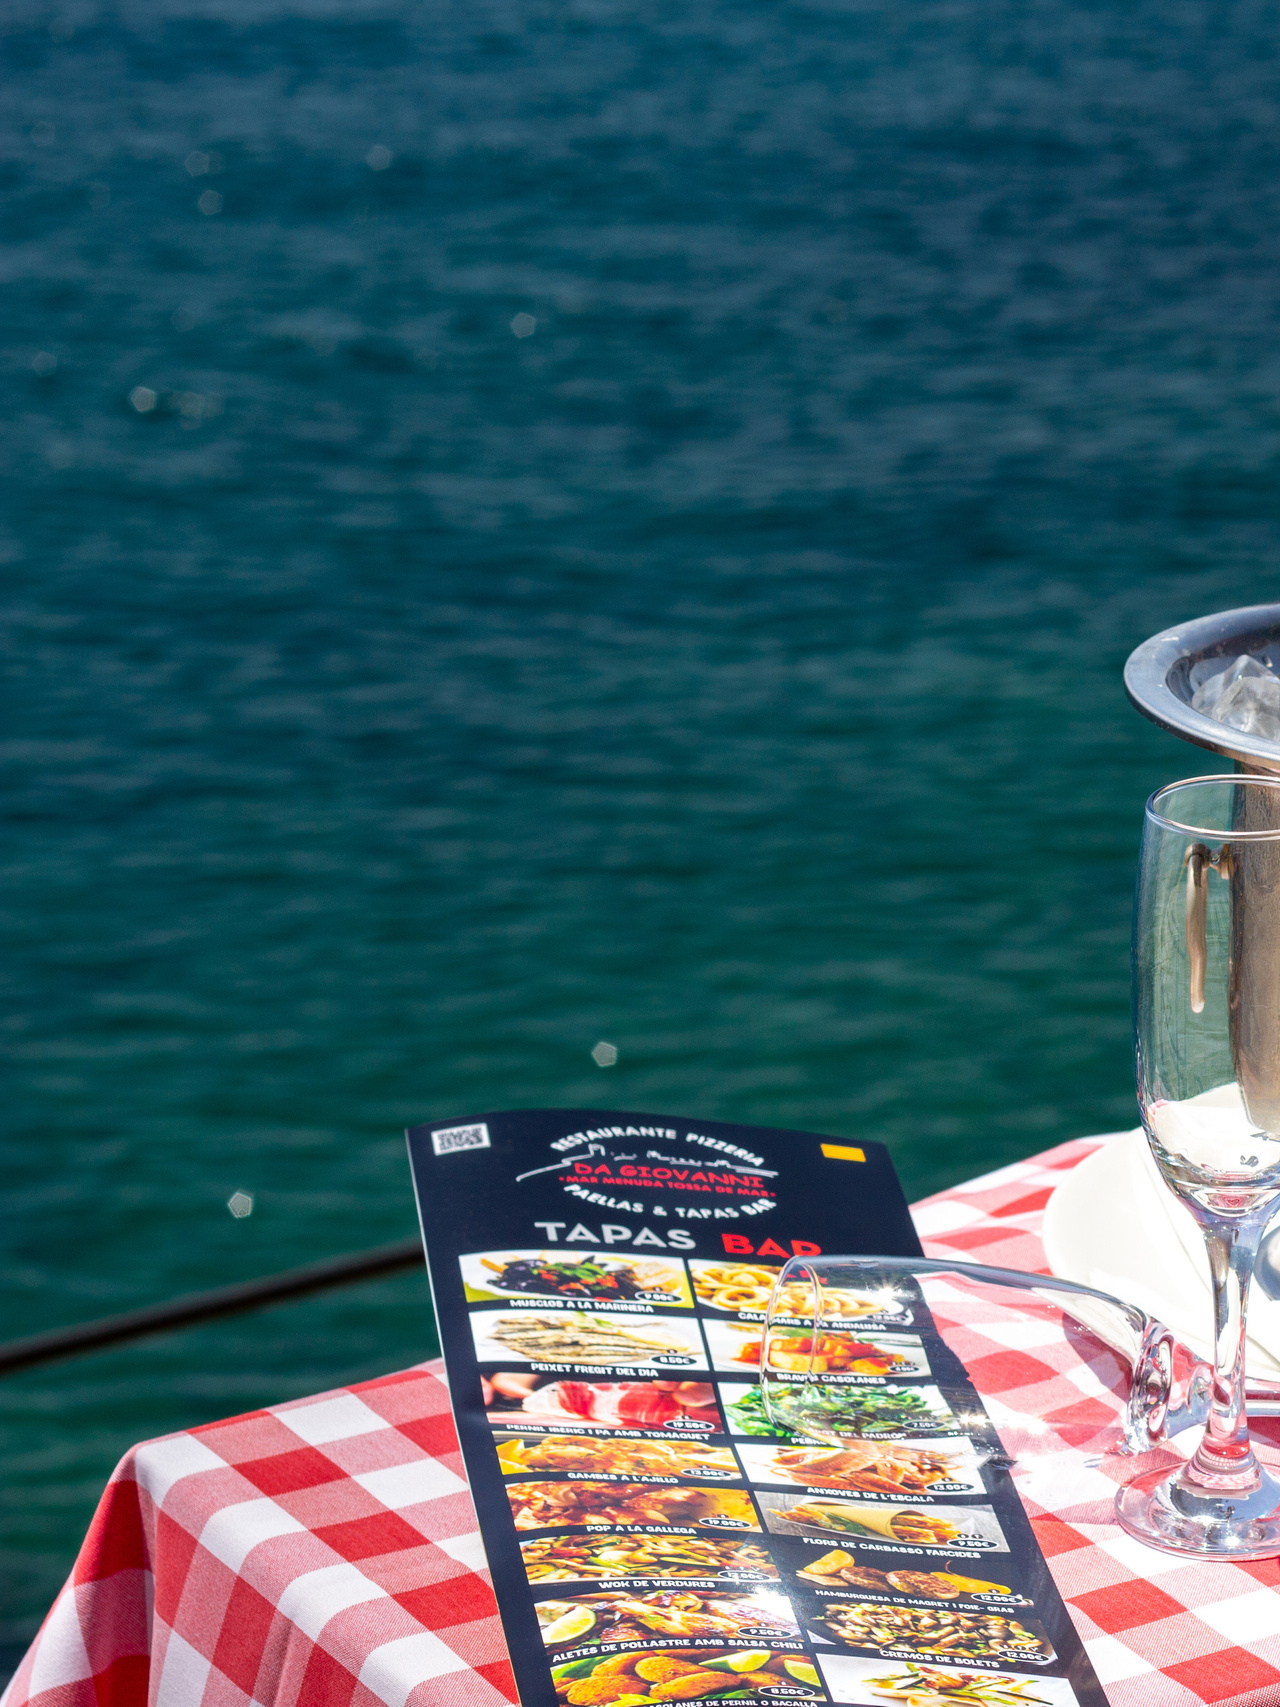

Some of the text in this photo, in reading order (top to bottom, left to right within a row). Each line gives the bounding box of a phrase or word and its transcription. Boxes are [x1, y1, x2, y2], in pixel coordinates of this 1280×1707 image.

[550, 1126, 764, 1166] RESTAURANTE PIZZERIA
[573, 1162, 764, 1188] DA GIOVANNI
[566, 1175, 768, 1197] MAR MENUDA TOSSA DE MAR
[564, 1184, 777, 1219] PAELLAS & TAPAS BAR
[534, 1222, 696, 1250] TAPAS
[510, 1299, 654, 1313] MUSCLOS A LA MARINERA
[803, 1319, 813, 1327] A
[832, 1322, 887, 1330] ANDALUSA
[531, 1362, 659, 1377] PEIXET FREGIT DEL DIA
[821, 1375, 886, 1384] CASOLANES
[506, 1424, 546, 1432] PERNIL
[567, 1473, 617, 1482] GAMBES
[632, 1475, 679, 1484] L'AJILLO
[807, 1487, 935, 1503] ANXOVES DE L'ESCALA
[586, 1525, 611, 1533] POP
[627, 1525, 643, 1533] LA
[646, 1525, 697, 1535] GALLEGA
[802, 1537, 839, 1548] FLORS
[841, 1540, 857, 1549] DE
[926, 1548, 981, 1559] FARCIDES
[598, 1580, 716, 1589] WOK DE VERDURES
[815, 1589, 891, 1602] HAMBURGUESA
[908, 1600, 950, 1609] MAGRET
[987, 1605, 1015, 1614] GRAS
[980, 1594, 1017, 1603] 12.00€
[552, 1637, 803, 1663] ALETES DE POLLASTRE AMB SALSA CHILI
[1006, 1651, 1044, 1661] 12.00€
[934, 1655, 952, 1664] DE
[954, 1657, 1000, 1668] BOLETS
